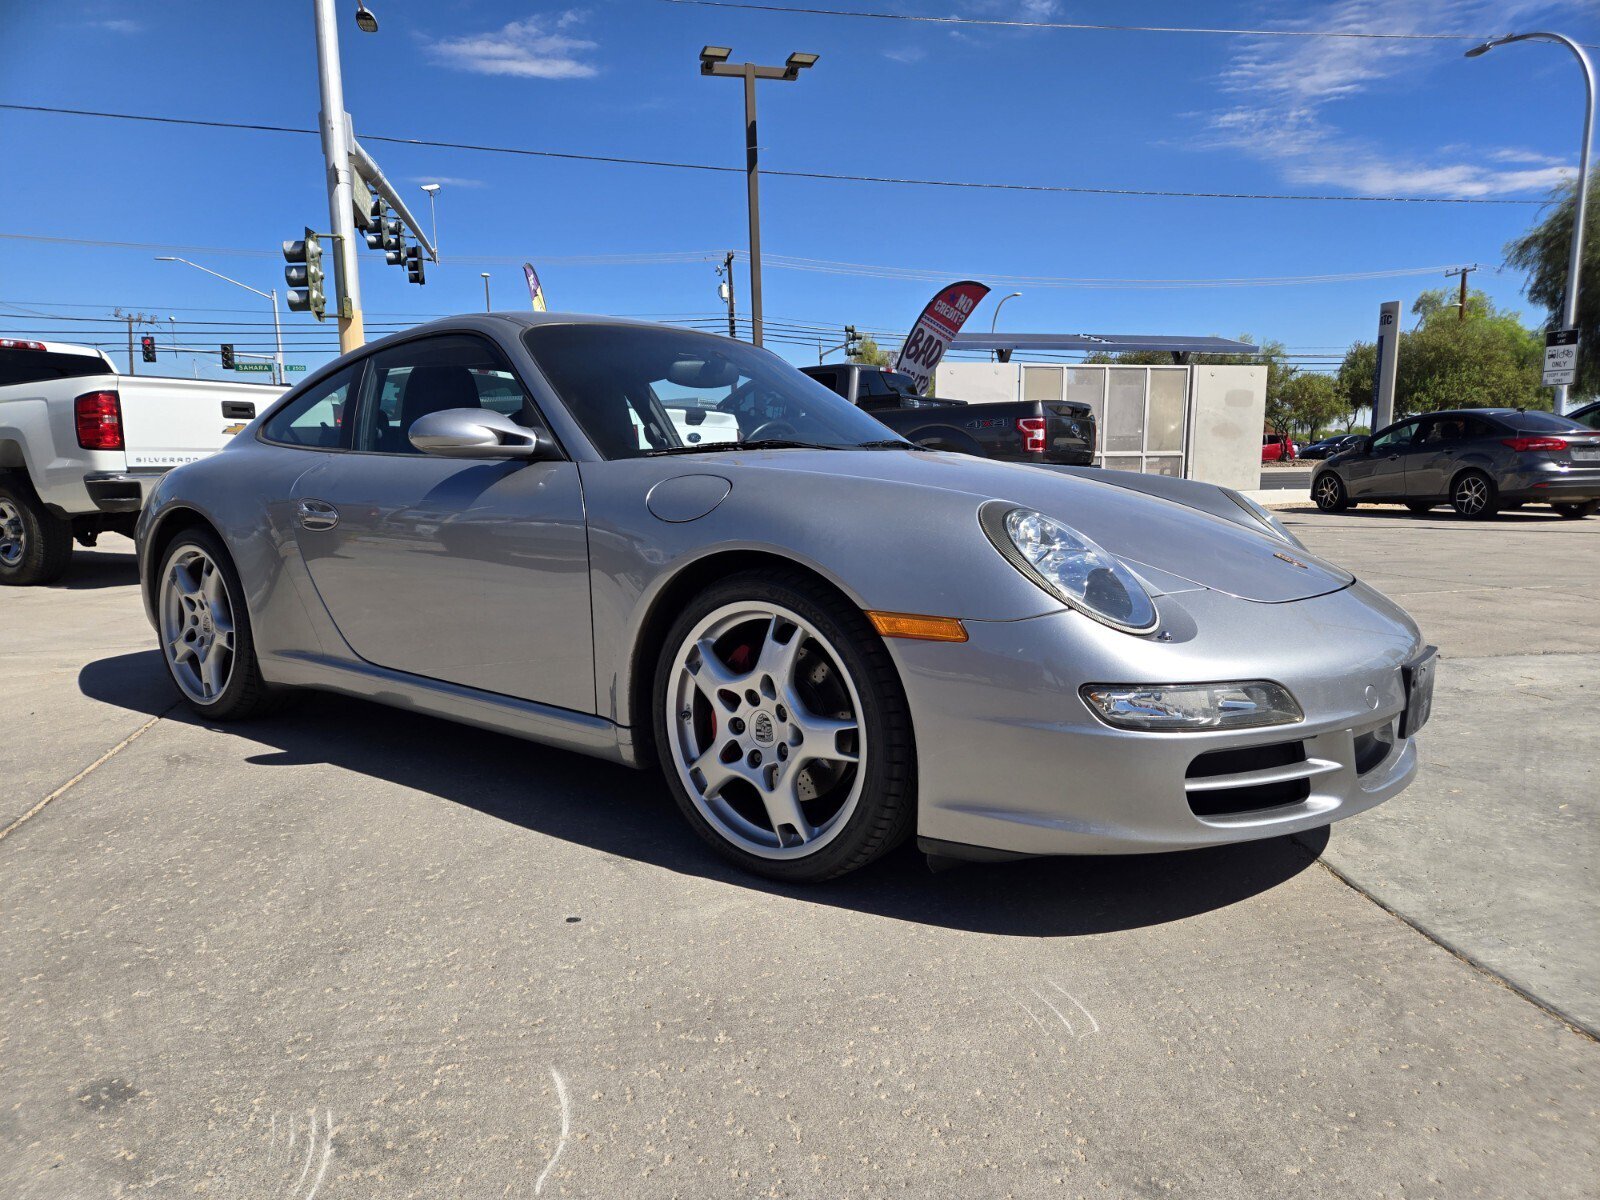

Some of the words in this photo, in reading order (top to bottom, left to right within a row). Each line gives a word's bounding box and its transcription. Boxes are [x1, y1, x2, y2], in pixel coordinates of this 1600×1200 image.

[933, 299, 966, 326] CREDIT?
[954, 294, 974, 314] NO
[905, 327, 943, 369] BAD
[1551, 360, 1568, 368] ONLY
